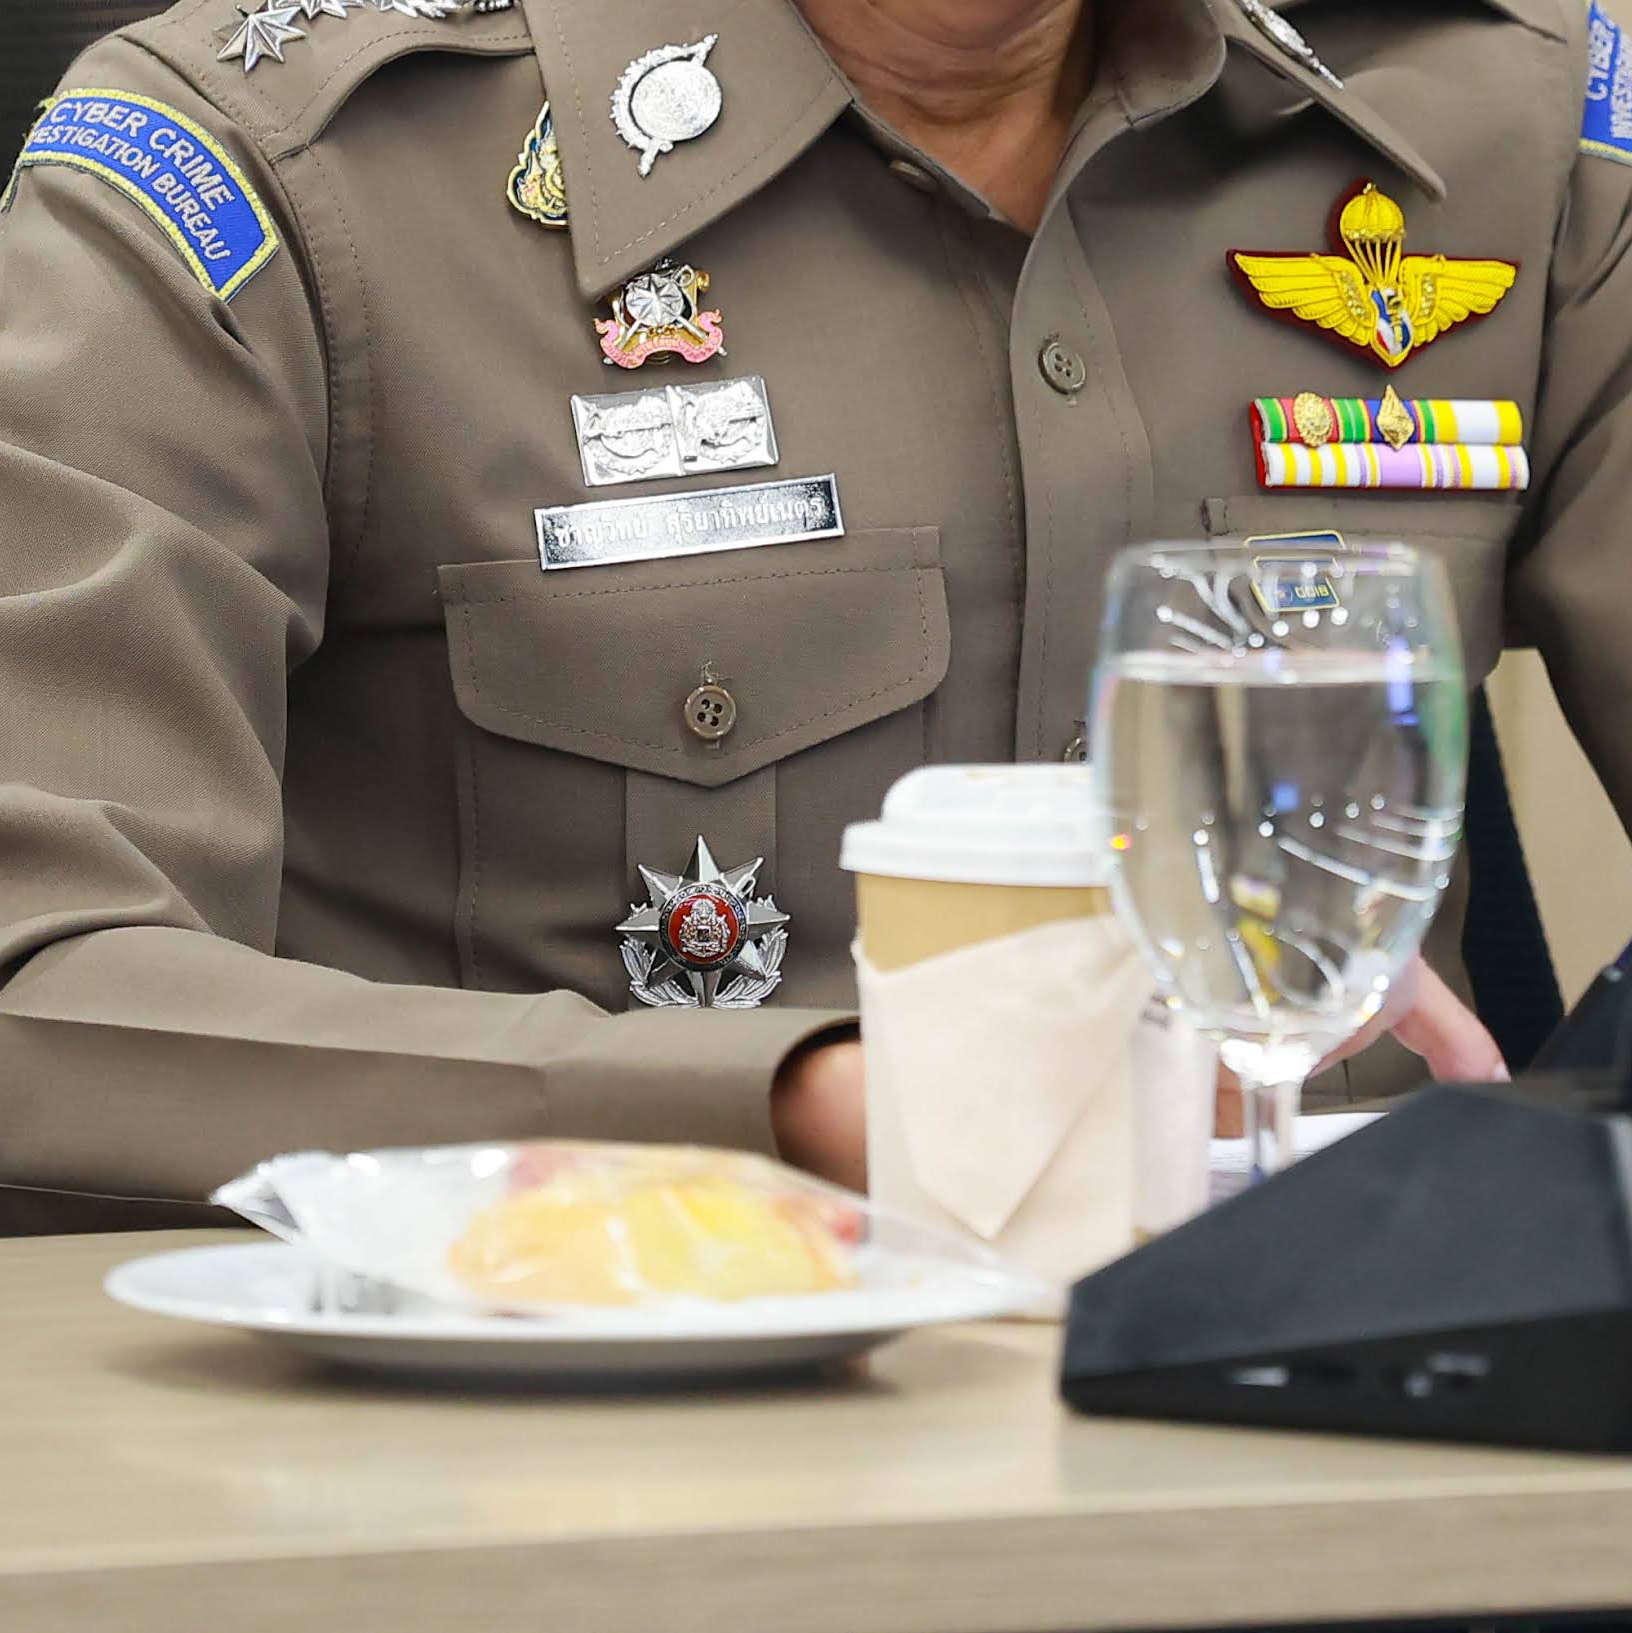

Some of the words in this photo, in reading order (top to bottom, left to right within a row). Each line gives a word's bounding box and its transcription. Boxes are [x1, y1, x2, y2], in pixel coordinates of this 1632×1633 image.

[31, 125, 159, 179] ESTIGATION
[151, 173, 231, 261] BUREAU
[50, 100, 149, 139] CYBER
[148, 127, 236, 212] CRIME
